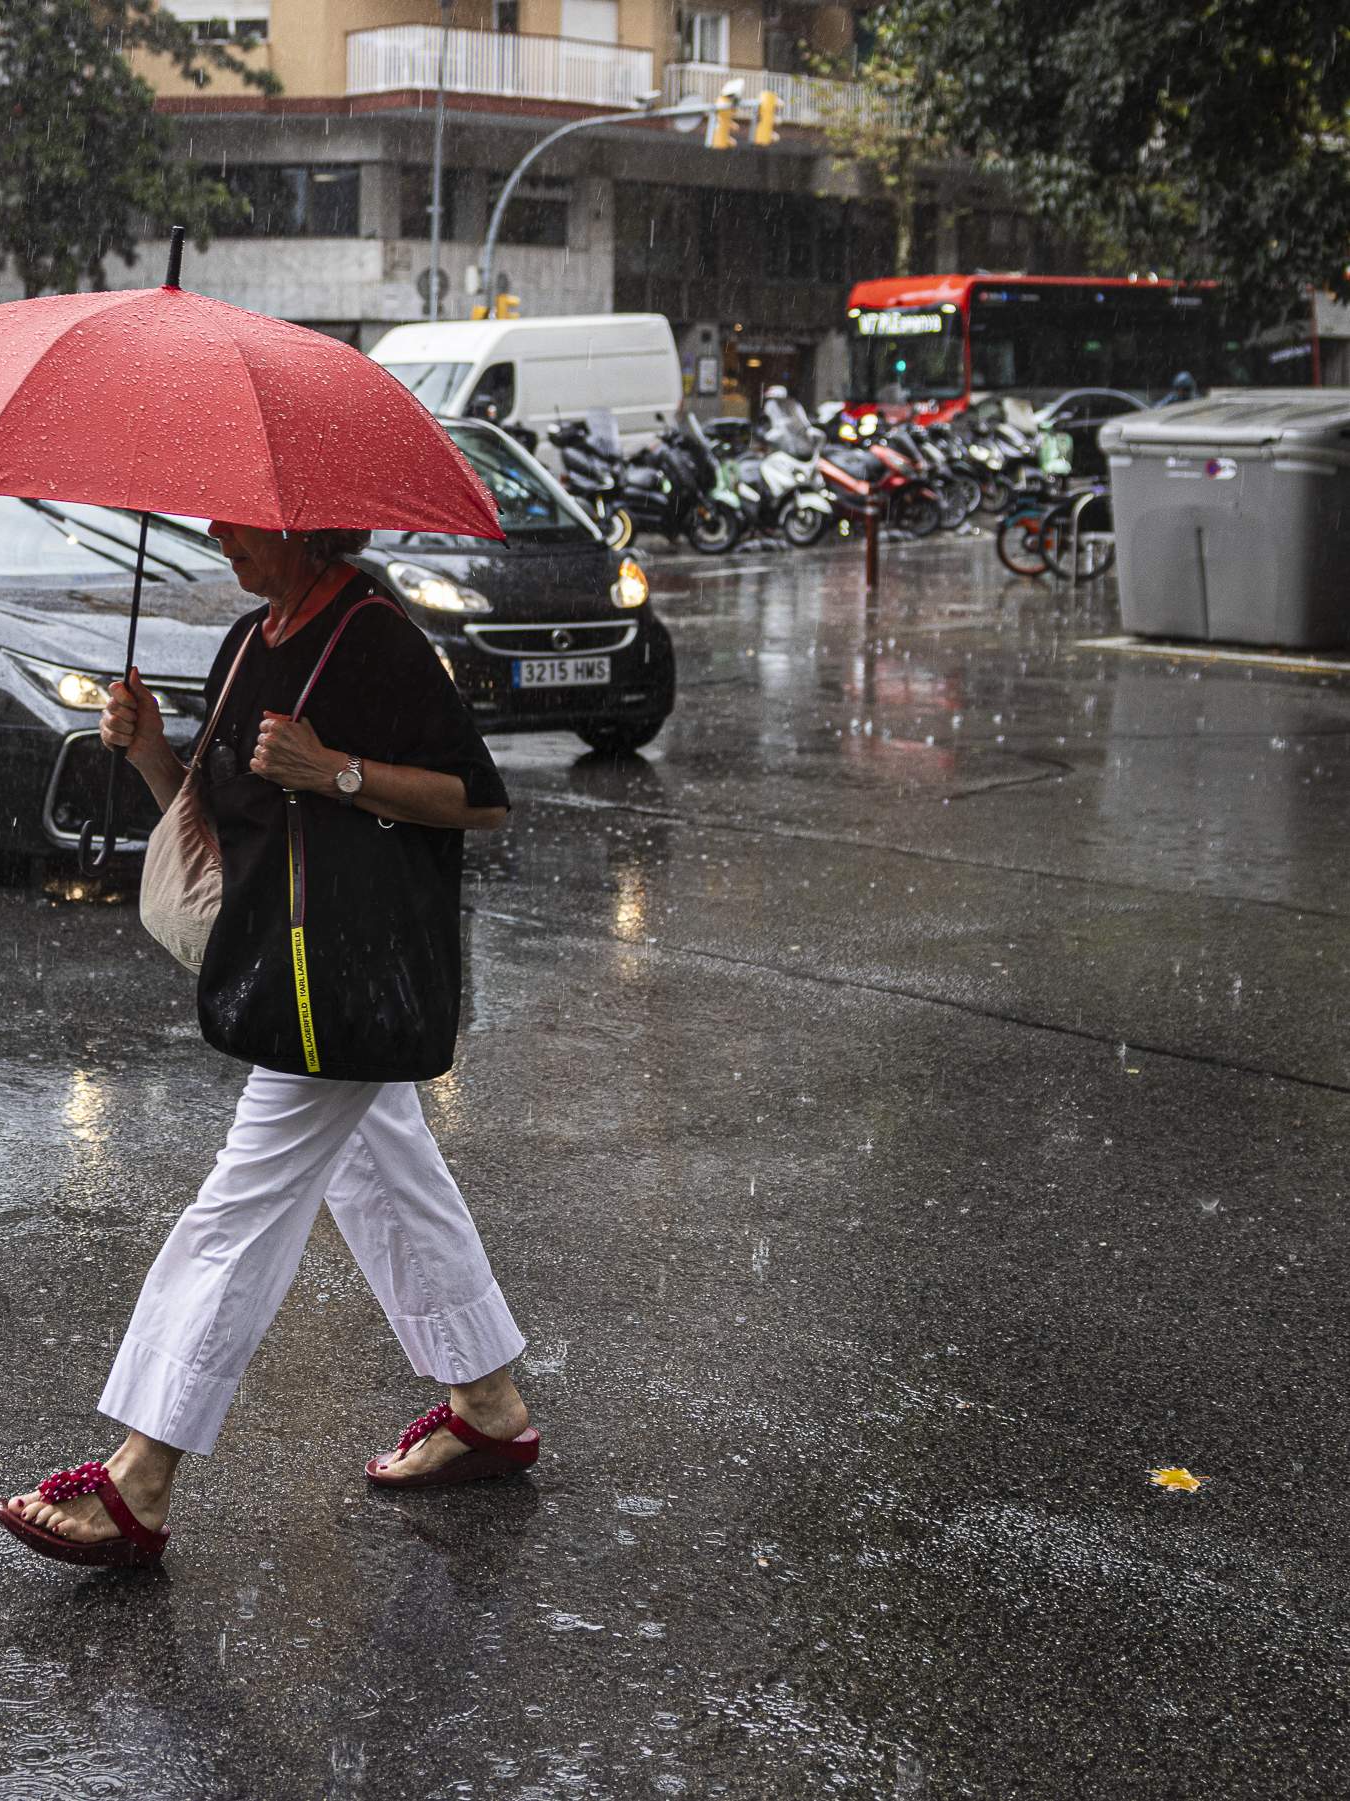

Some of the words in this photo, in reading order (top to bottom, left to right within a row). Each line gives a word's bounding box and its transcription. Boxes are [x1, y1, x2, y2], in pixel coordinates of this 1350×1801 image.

[525, 661, 568, 682] 3215
[294, 931, 304, 976] LAGERFELD
[301, 1002, 313, 1048] LAGERFELD
[307, 1048, 316, 1067] KARL
